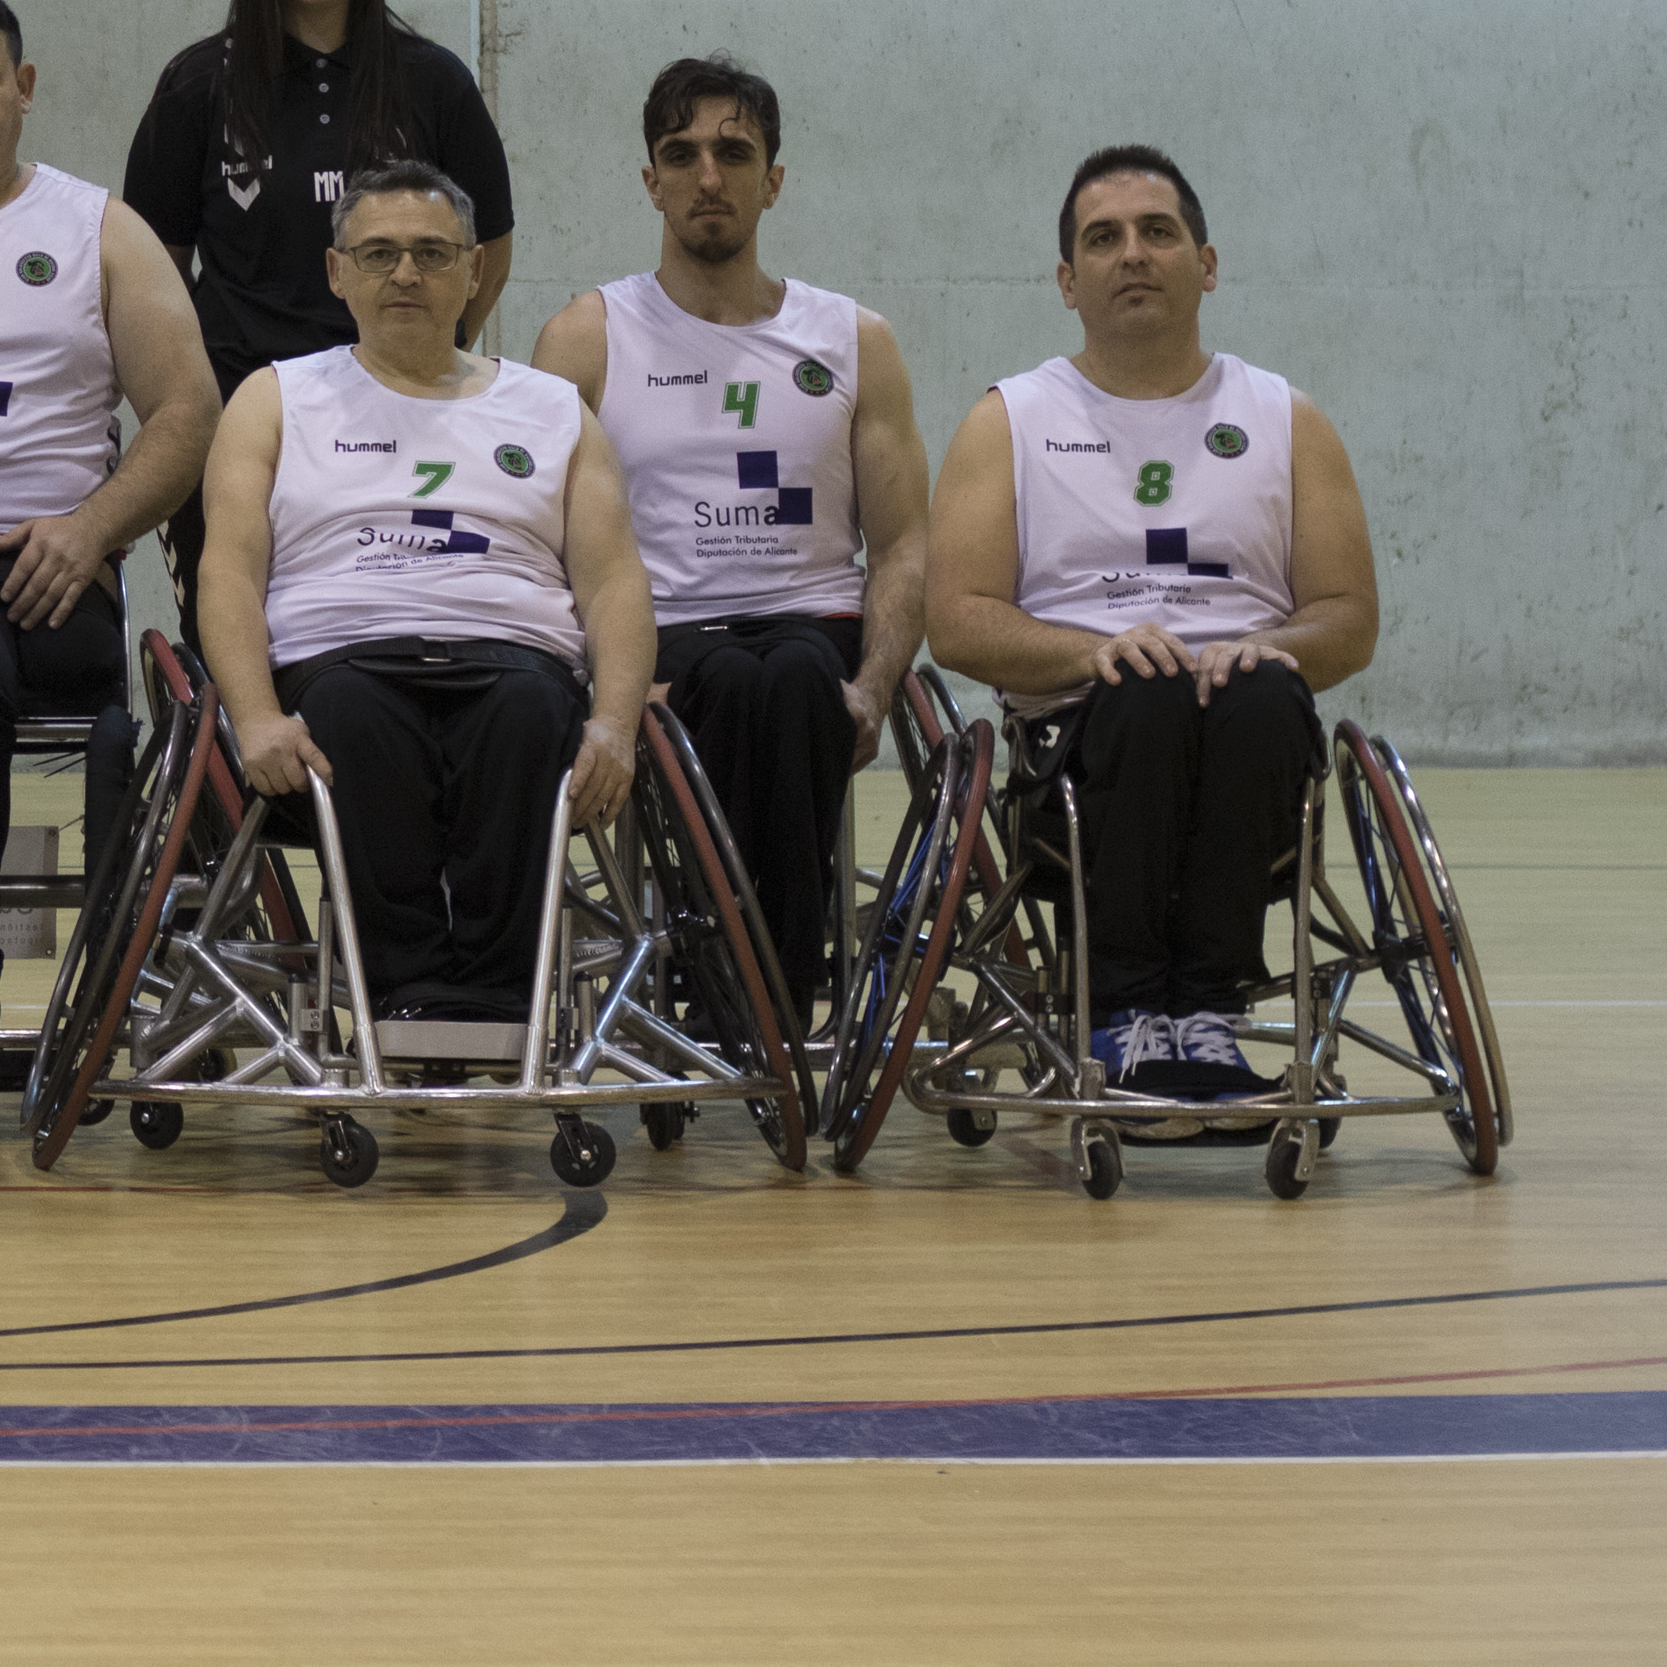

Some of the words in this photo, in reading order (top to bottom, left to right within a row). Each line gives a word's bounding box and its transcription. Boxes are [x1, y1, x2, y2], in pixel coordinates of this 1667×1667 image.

[314, 171, 345, 202] MM
[648, 370, 708, 387] hummel
[722, 381, 761, 429] 4
[334, 439, 397, 453] hummel
[1046, 438, 1111, 453] hummel
[407, 460, 456, 499] 7
[1134, 459, 1175, 507] 8
[694, 501, 780, 528] Suma
[357, 527, 448, 552] Suma
[696, 535, 732, 546] Gestión
[735, 535, 779, 544] Tributaria
[357, 553, 391, 563] Gestión
[697, 547, 747, 558] Diputación
[750, 547, 762, 556] de
[764, 547, 798, 556] Alicante
[1107, 587, 1144, 601] Gestión
[1147, 584, 1191, 594] Tributaria
[1107, 596, 1160, 610] Diputación
[1162, 595, 1174, 605] de
[1175, 596, 1211, 606] Alicante
